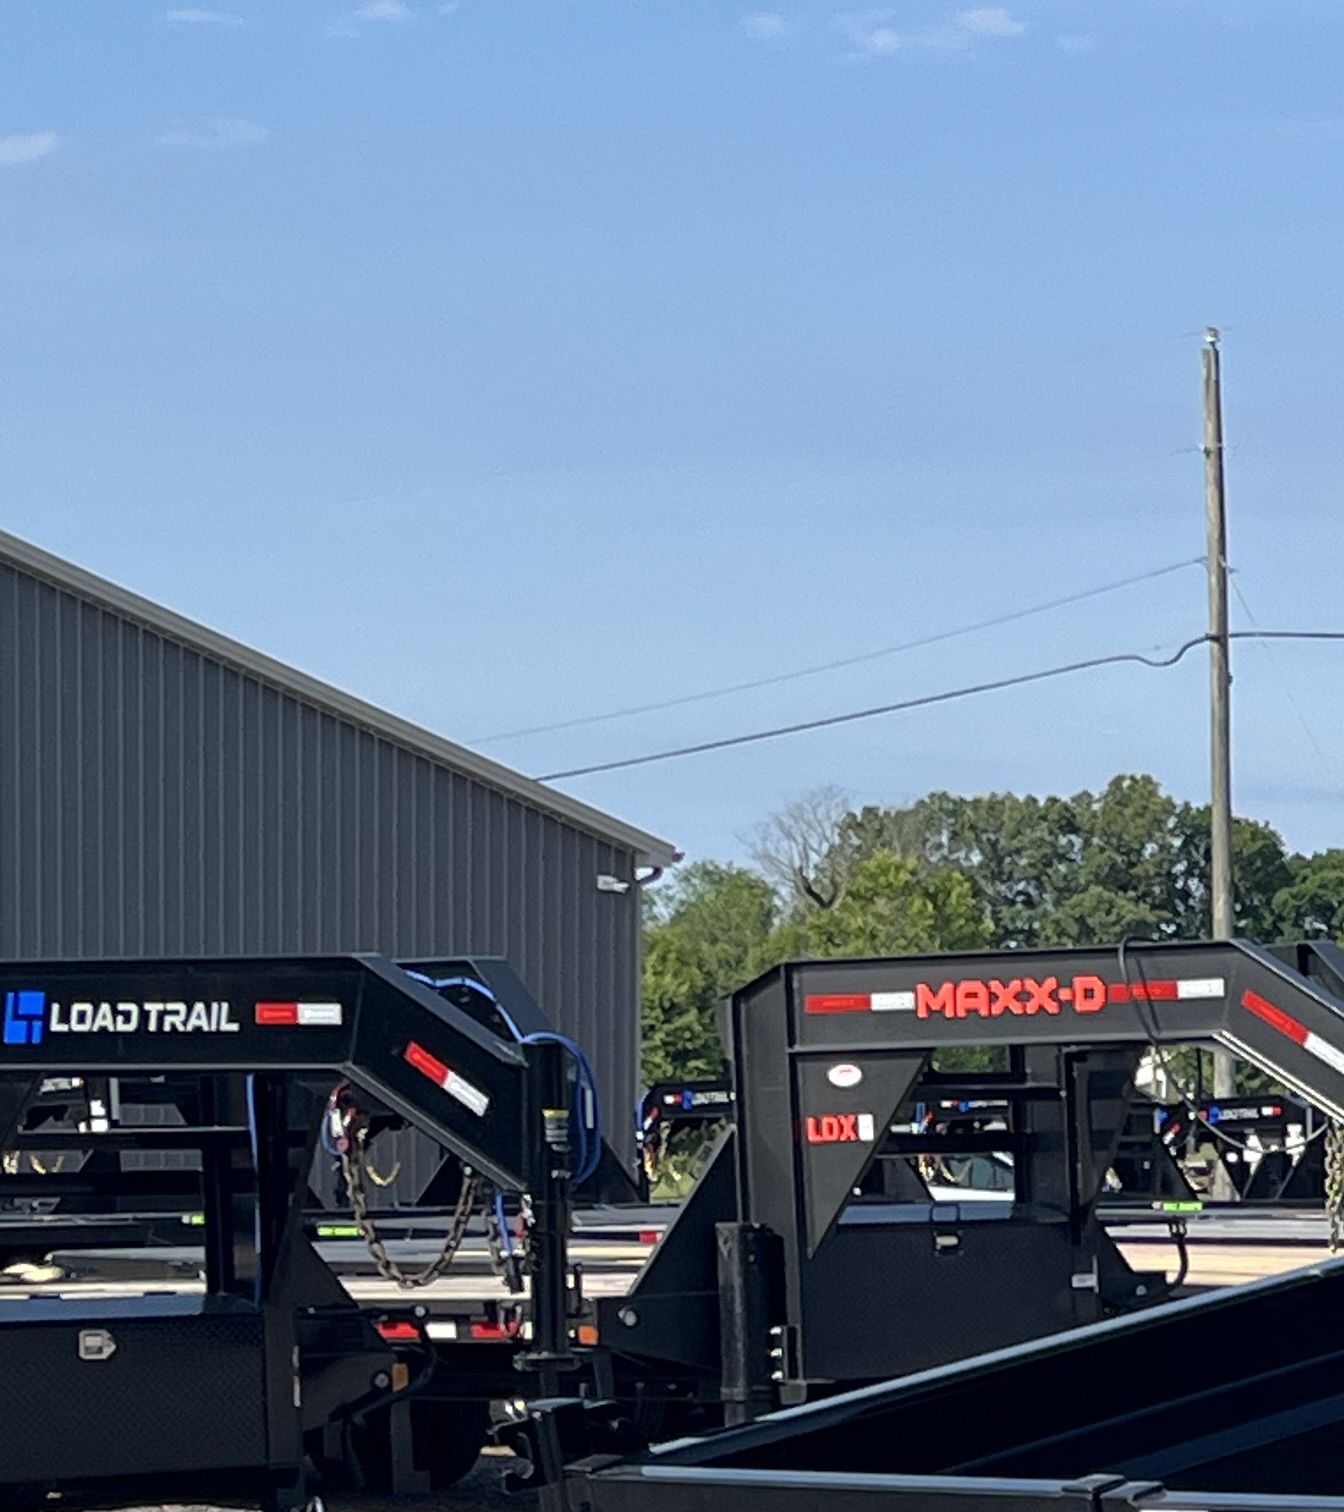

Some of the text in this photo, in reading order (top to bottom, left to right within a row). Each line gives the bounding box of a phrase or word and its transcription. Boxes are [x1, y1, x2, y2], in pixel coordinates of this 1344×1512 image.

[916, 976, 1106, 1018] MAXX-D
[50, 1002, 240, 1032] LOAD TRAIL
[806, 1114, 857, 1142] LDX
